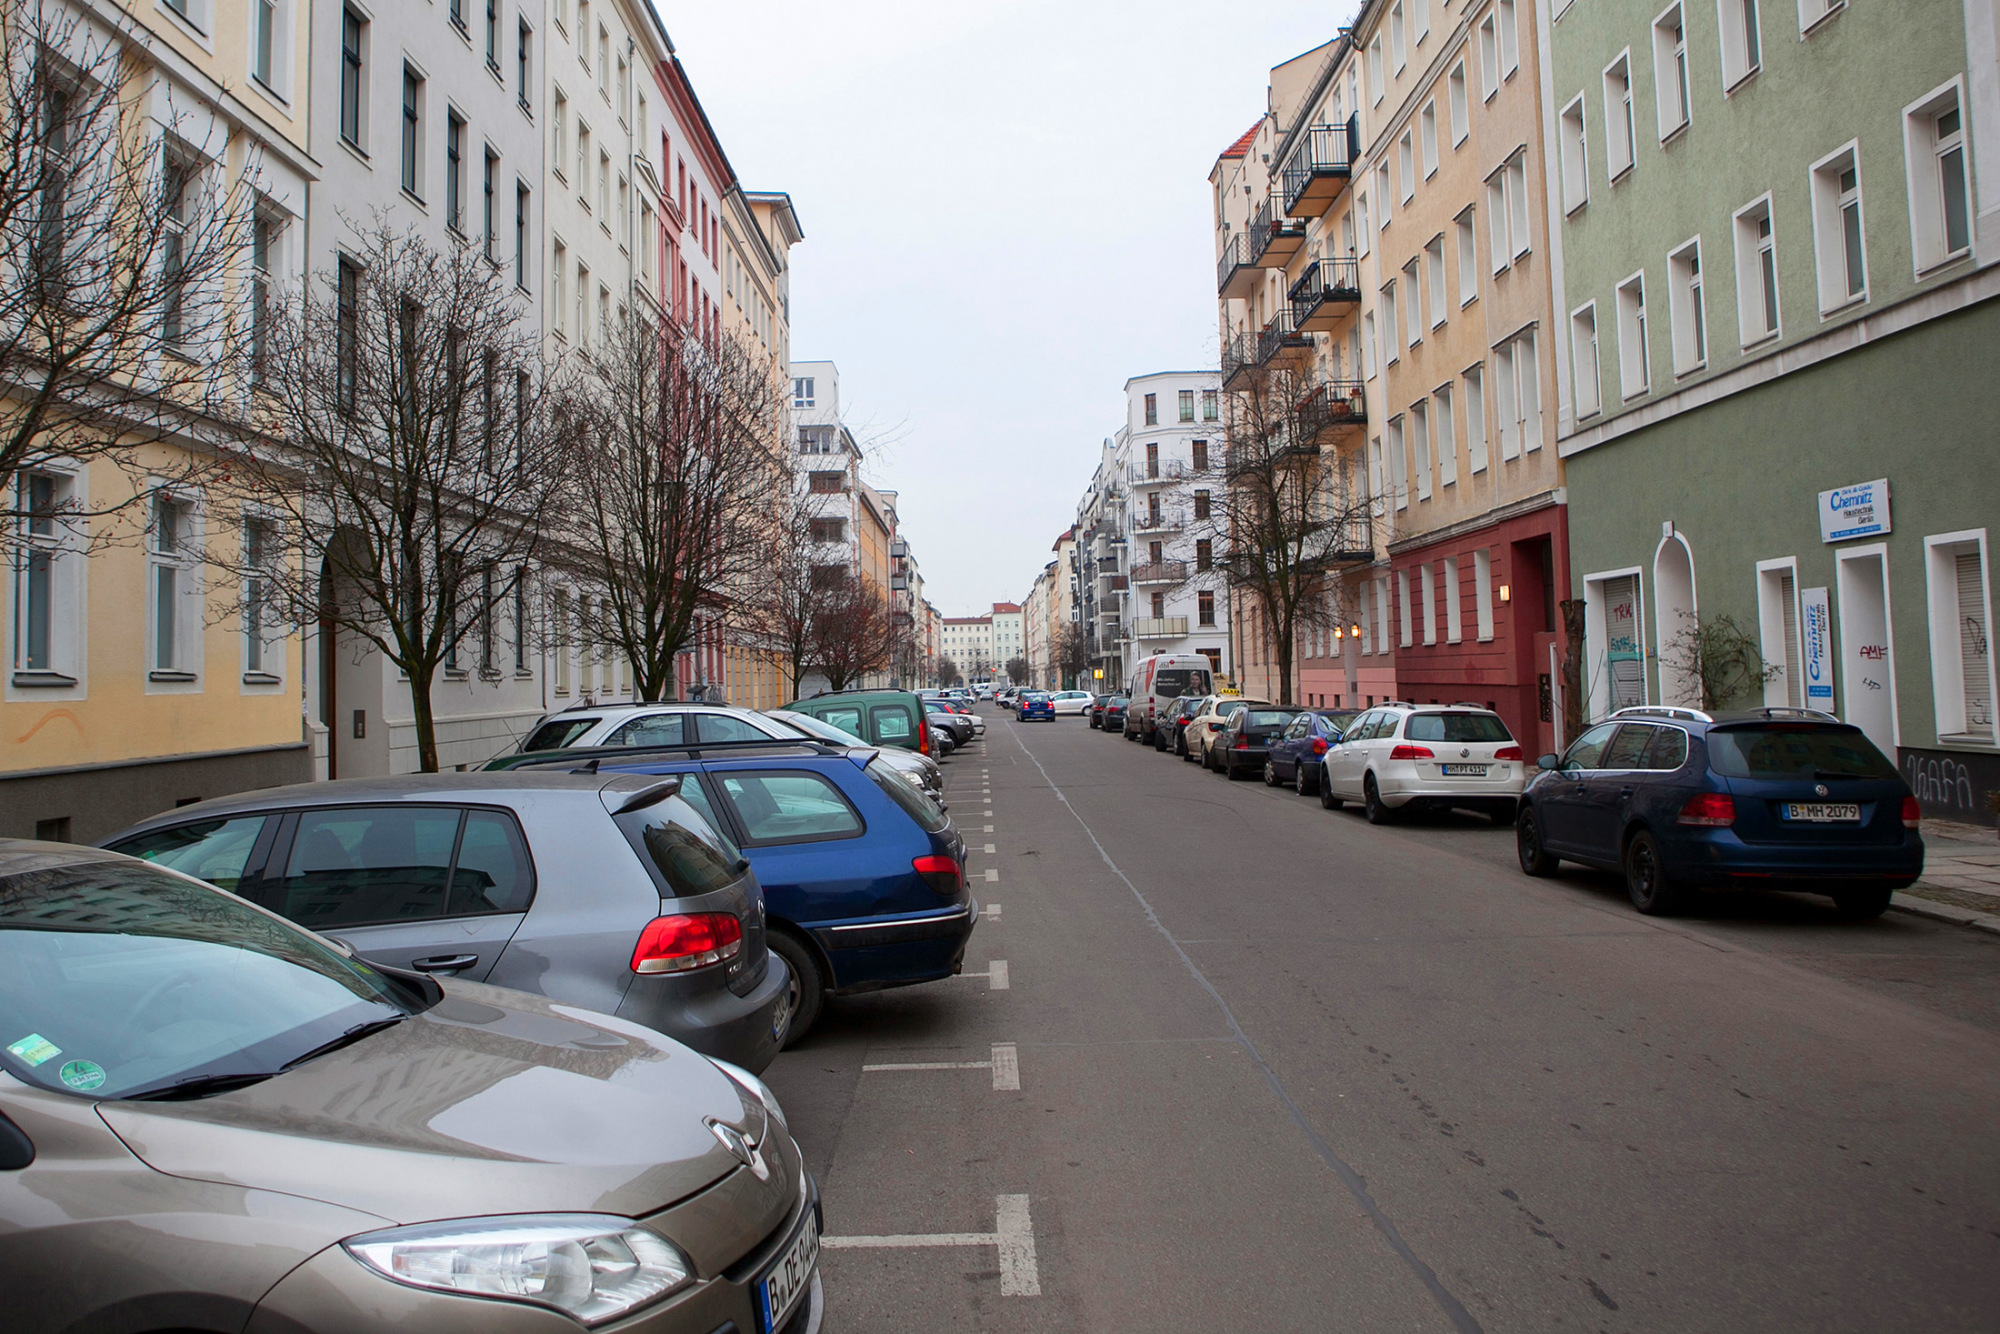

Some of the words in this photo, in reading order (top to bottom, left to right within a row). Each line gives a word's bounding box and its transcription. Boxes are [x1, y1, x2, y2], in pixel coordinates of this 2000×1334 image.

[1830, 491, 1873, 512] Chemnitz
[1843, 504, 1874, 518] Haustechnik
[1858, 515, 1874, 525] Berlin
[1809, 605, 1820, 681] Chemnitz
[1460, 764, 1467, 773] PT
[1790, 805, 1799, 817] B
[1807, 805, 1824, 818] MH
[1825, 805, 1857, 818] 2079
[768, 1275, 780, 1318] B
[785, 1247, 801, 1299] DE
